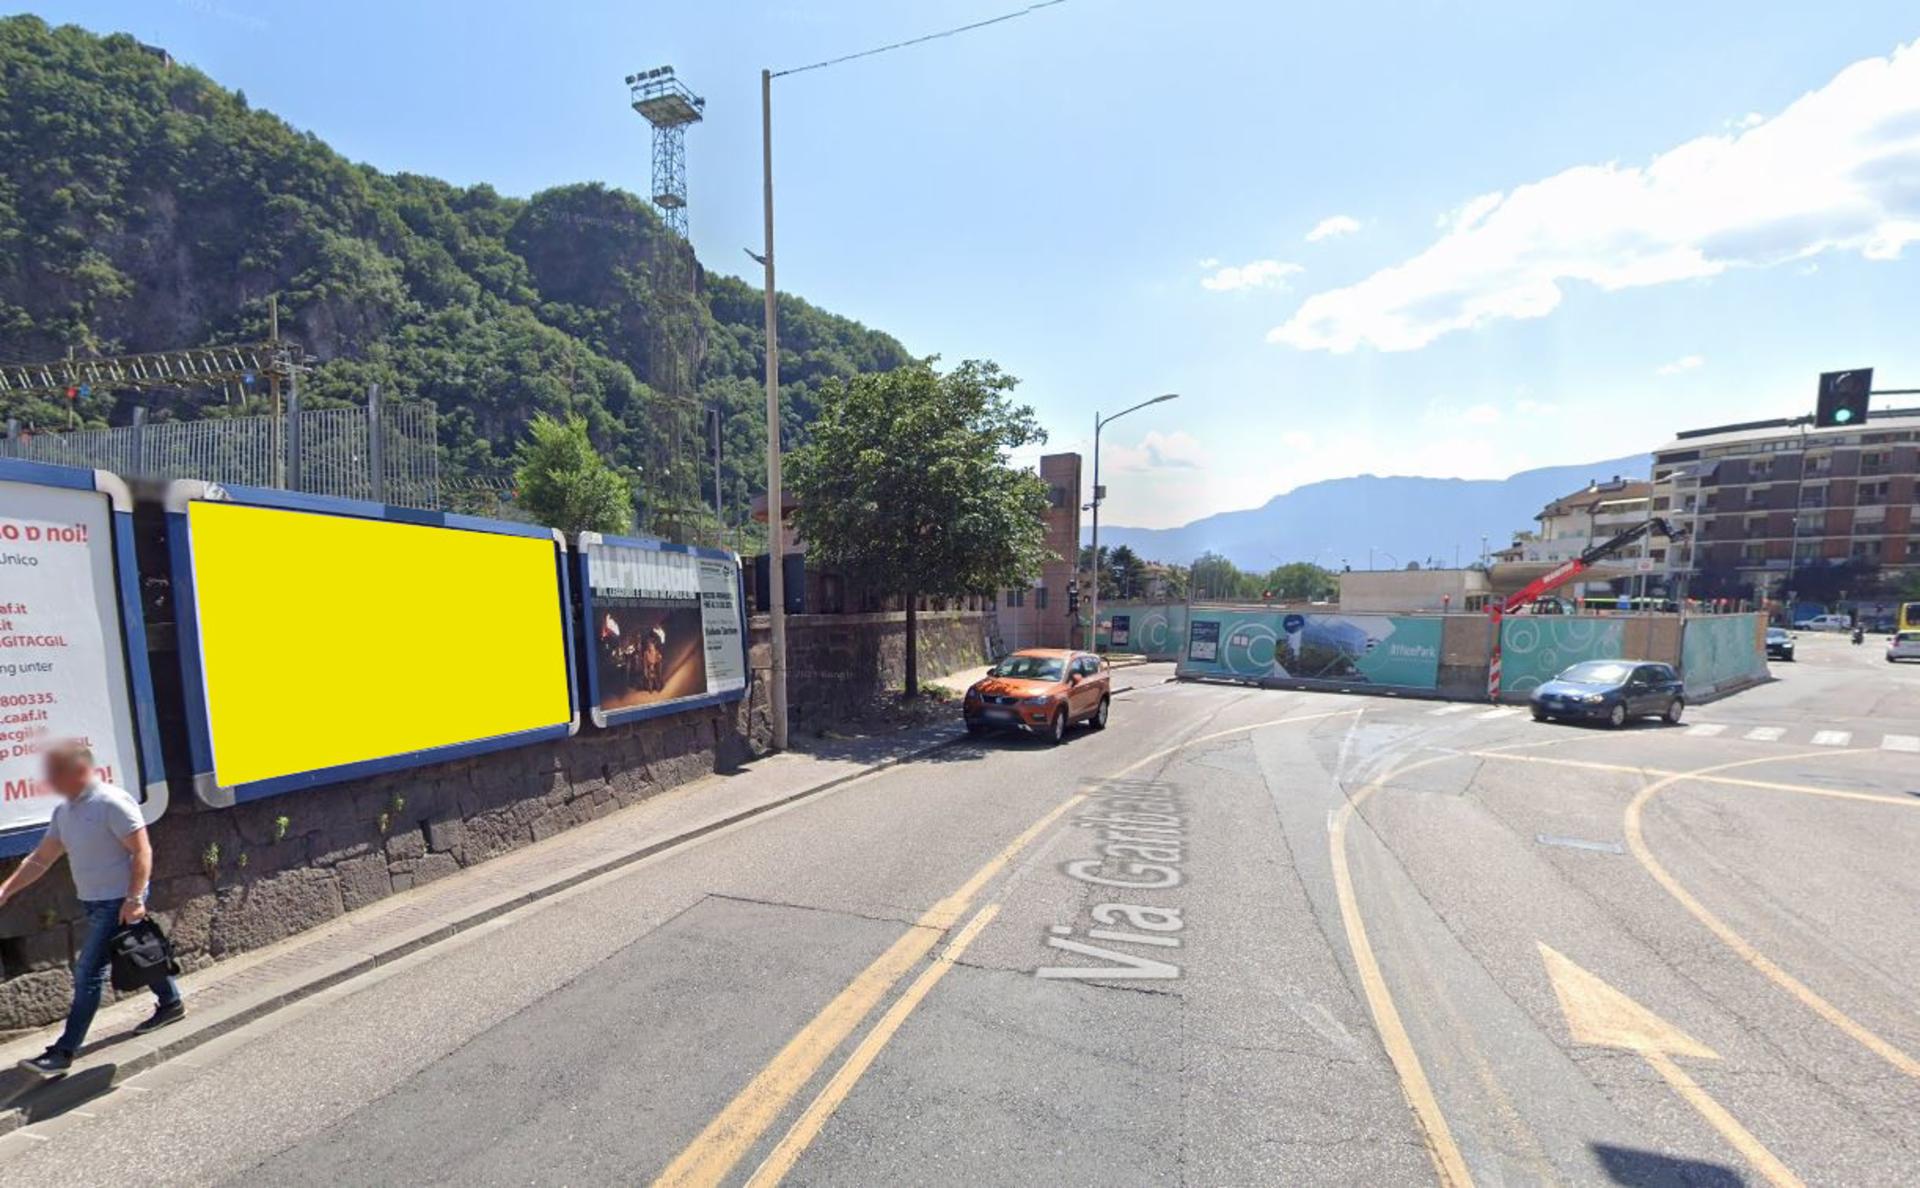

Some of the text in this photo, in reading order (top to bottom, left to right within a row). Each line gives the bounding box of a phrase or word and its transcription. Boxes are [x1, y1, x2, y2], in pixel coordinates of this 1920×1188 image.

[47, 523, 88, 543] noi!
[0, 636, 67, 648] GITACGIL
[20, 662, 53, 672] unter
